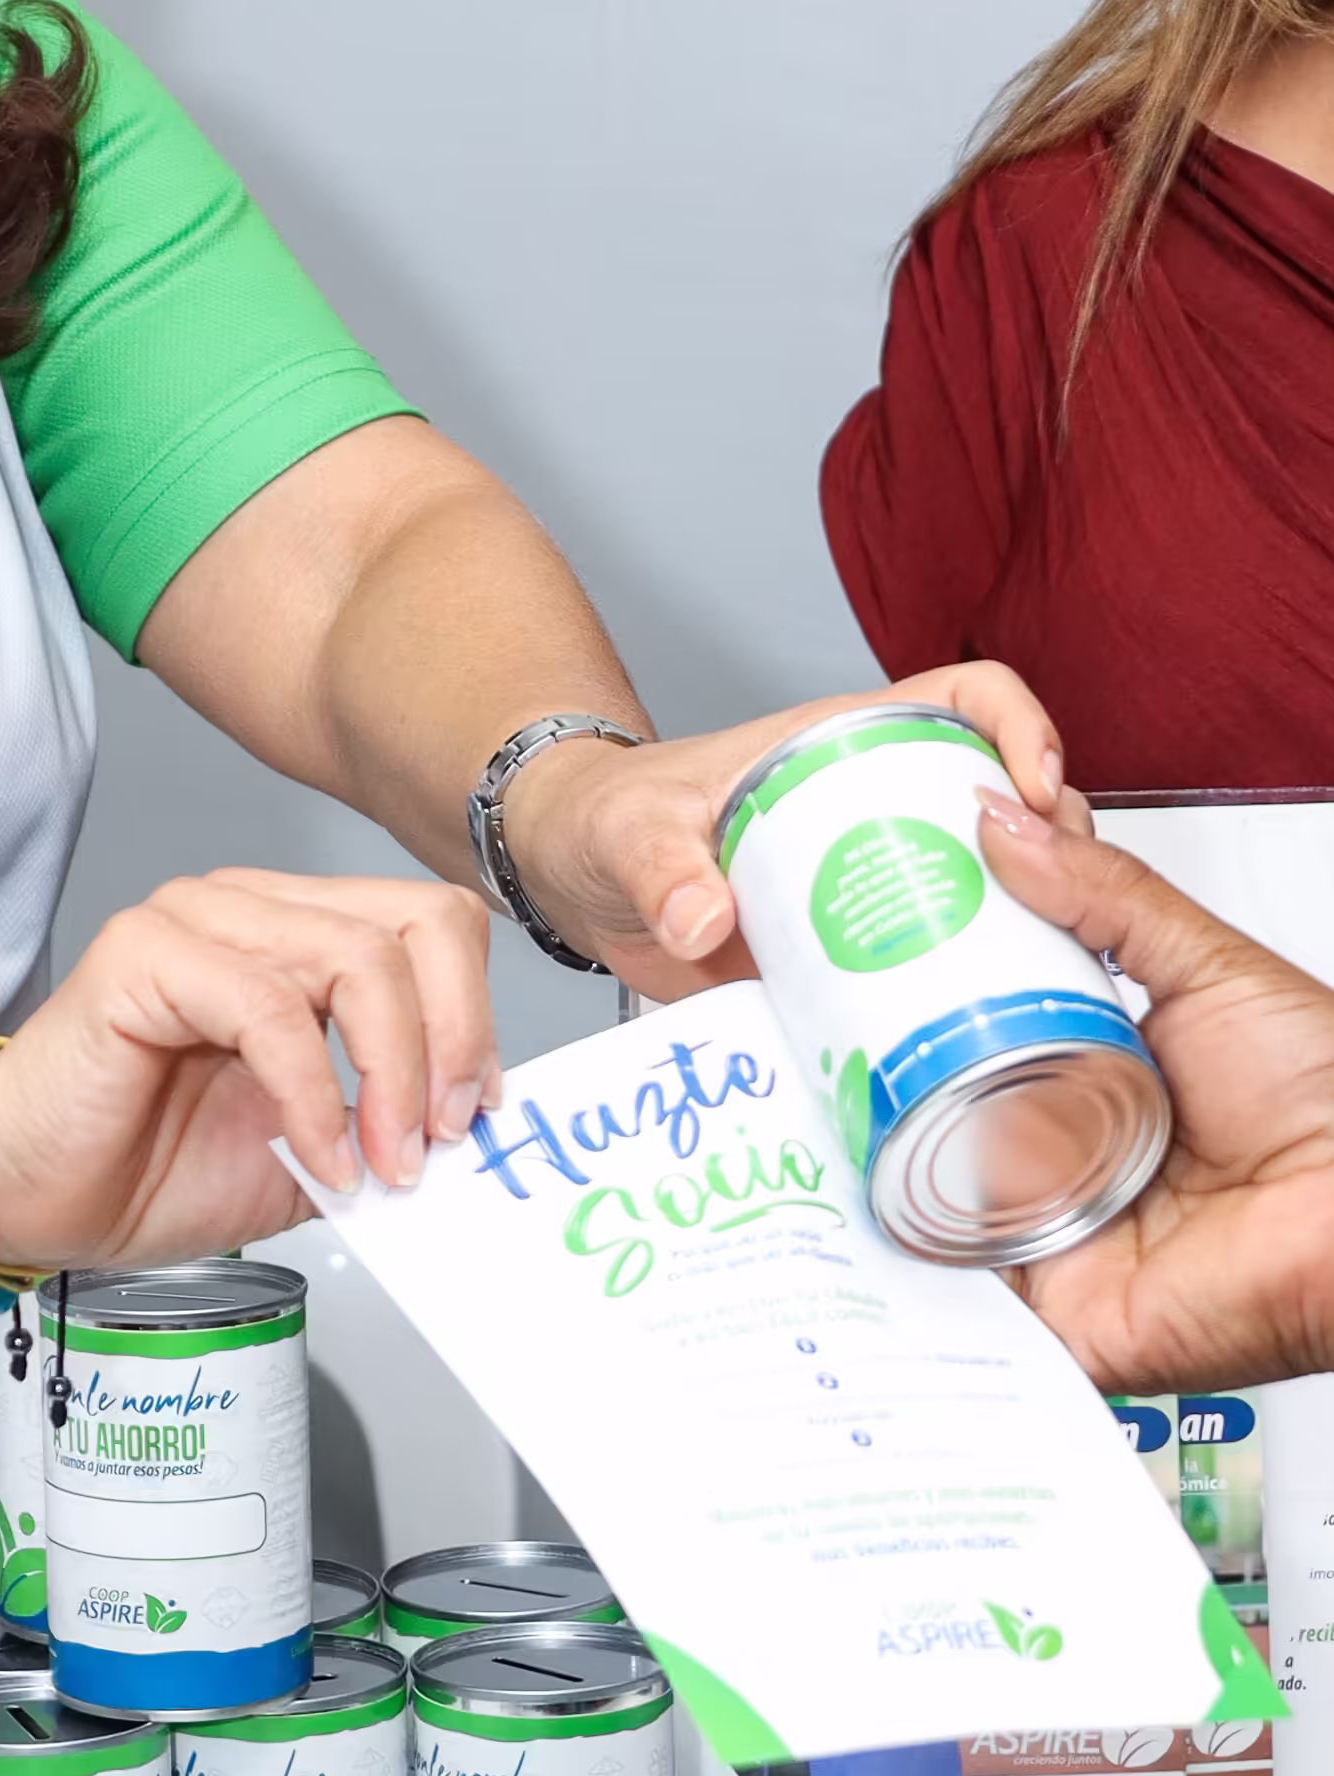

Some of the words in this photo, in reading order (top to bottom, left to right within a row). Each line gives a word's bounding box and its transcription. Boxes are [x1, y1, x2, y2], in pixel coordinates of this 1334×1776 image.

[470, 1039, 776, 1200] Hazte
[563, 1124, 825, 1297] Socio
[121, 1364, 240, 1417] nombre
[67, 1416, 89, 1455] TU
[96, 1421, 206, 1463] AHORRO!
[1179, 1409, 1225, 1442] an
[94, 1463, 132, 1477] juntar
[133, 1463, 160, 1477] esos
[163, 1458, 205, 1480] pesos!
[77, 1599, 145, 1625] ASPIRE
[88, 1586, 129, 1602] COOP
